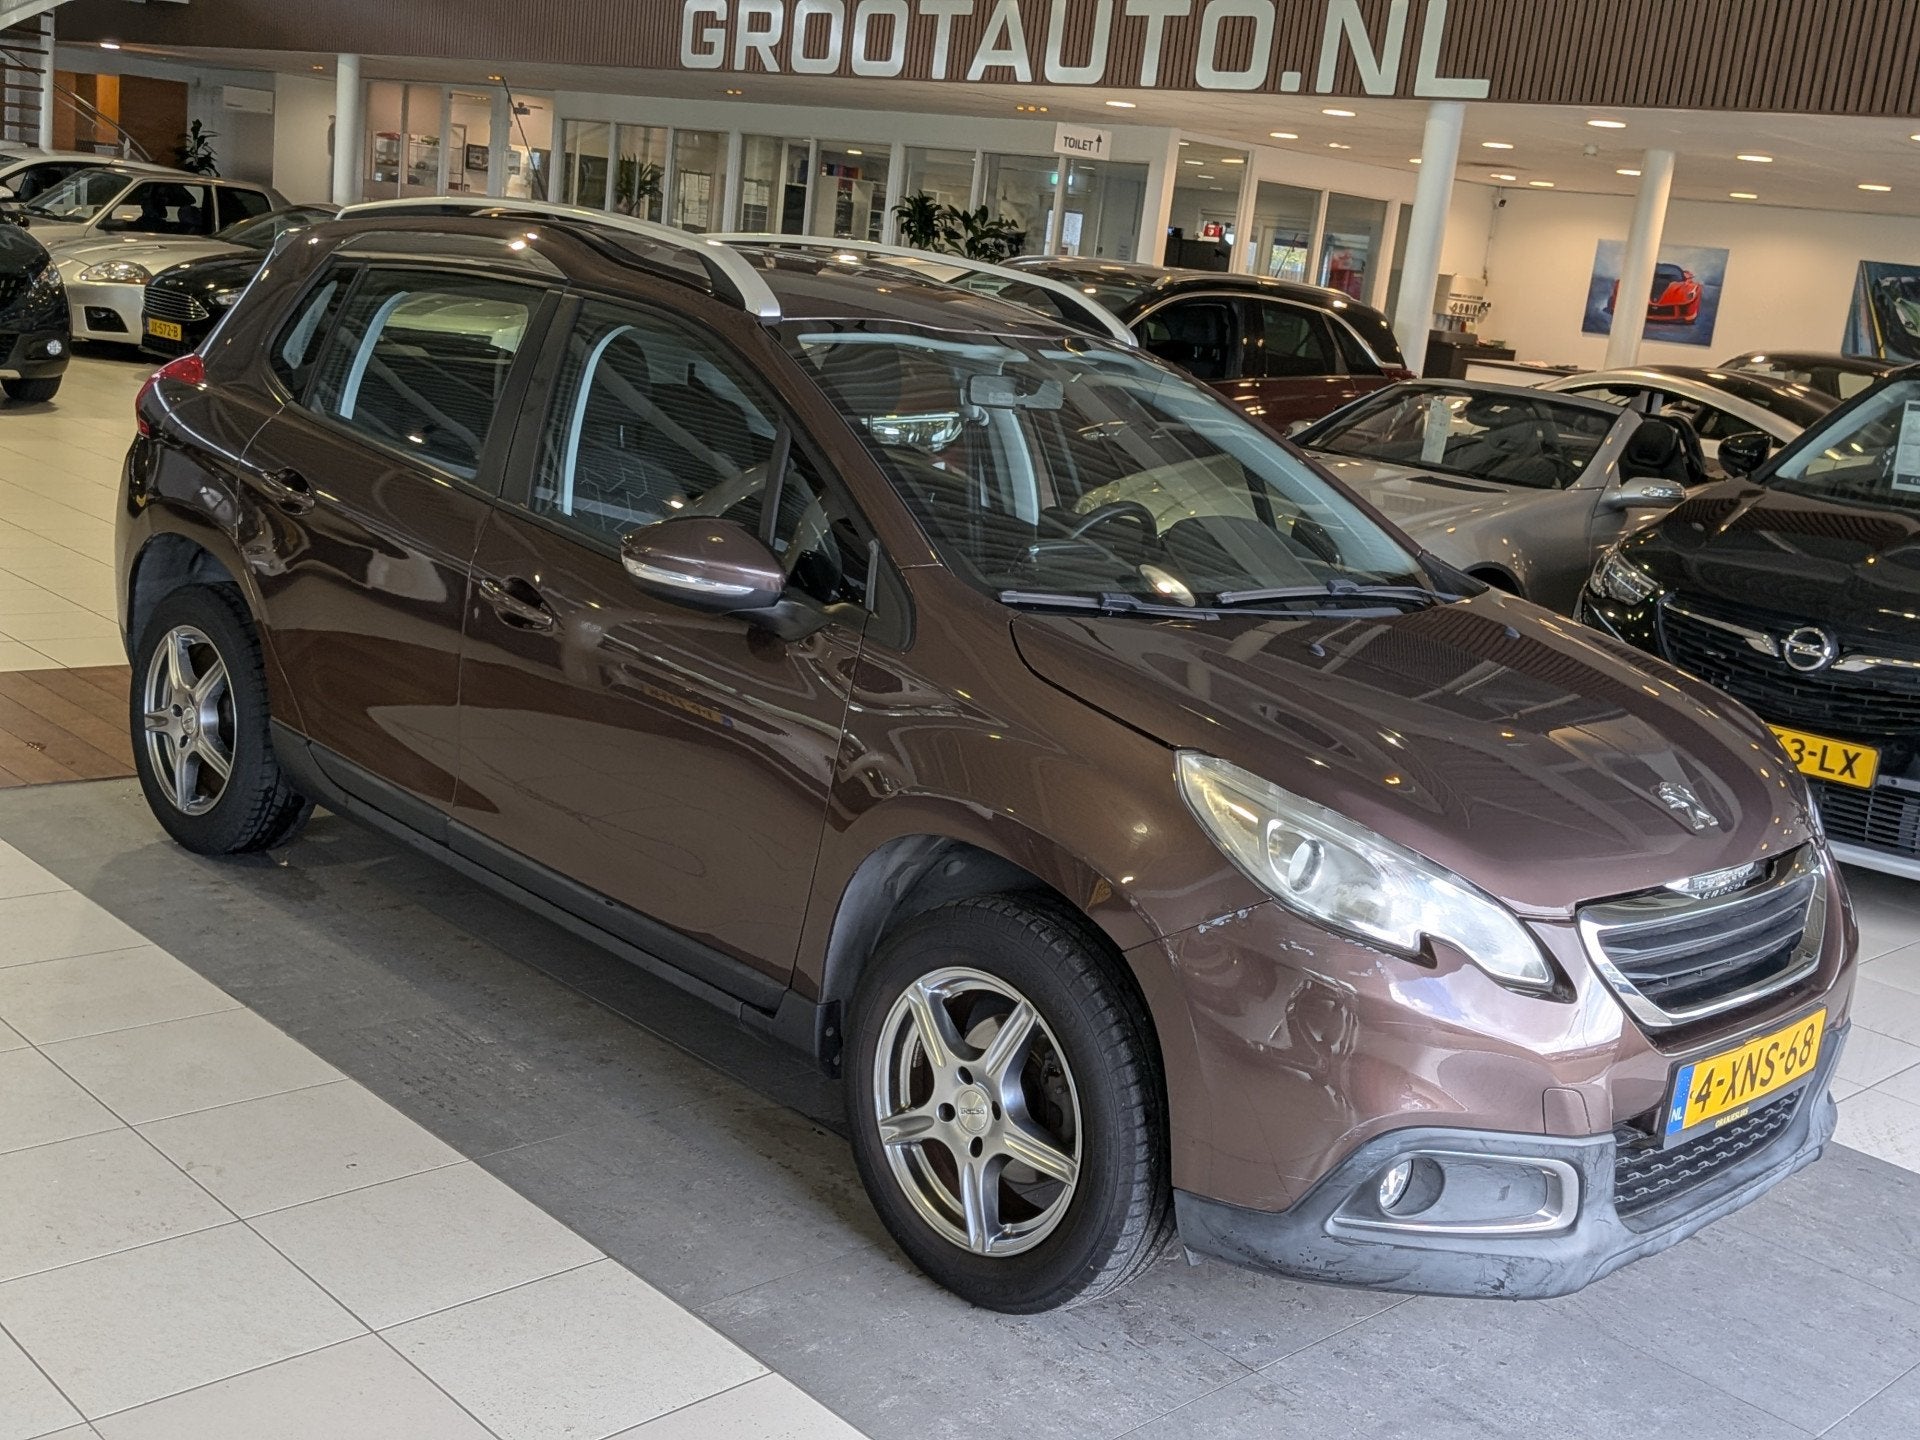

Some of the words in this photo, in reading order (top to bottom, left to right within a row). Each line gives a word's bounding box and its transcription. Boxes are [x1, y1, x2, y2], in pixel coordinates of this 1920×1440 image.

[680, 0, 1490, 99] GROOTAUTO.NL
[1063, 135, 1094, 152] TOILET
[1777, 734, 1862, 779] 3-LX
[1694, 1022, 1815, 1113] 4-XNS-68
[1670, 1106, 1683, 1123] NL
